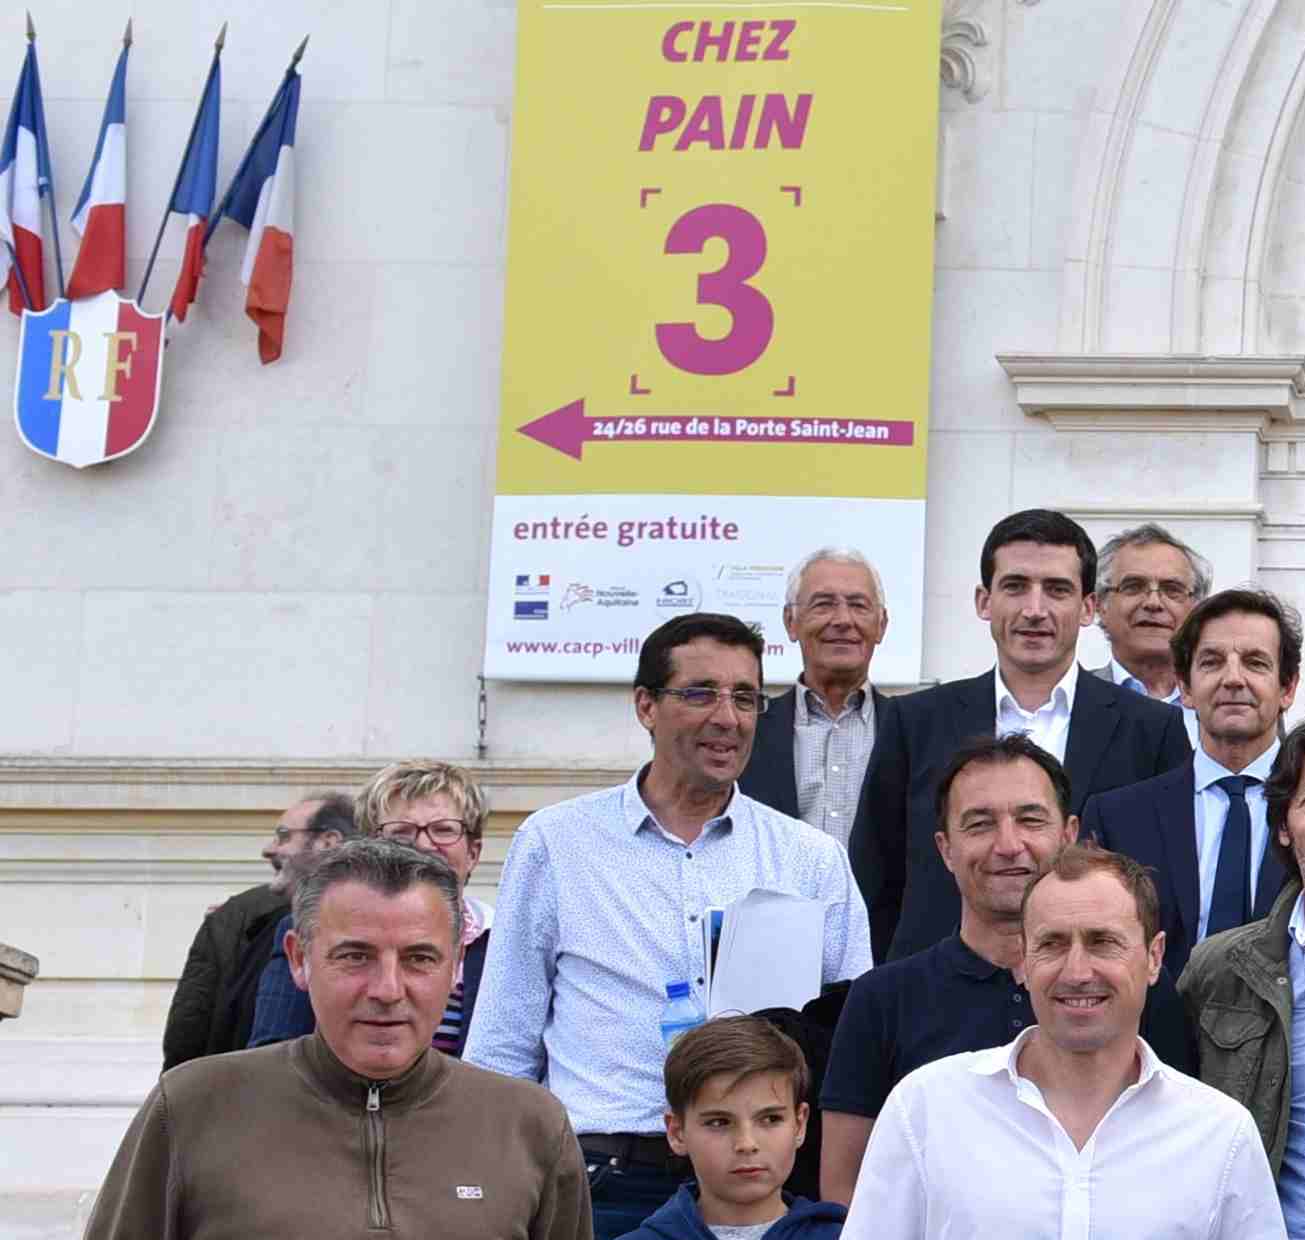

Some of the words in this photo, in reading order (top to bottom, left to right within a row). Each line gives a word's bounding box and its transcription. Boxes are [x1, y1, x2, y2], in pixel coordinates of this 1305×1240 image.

[661, 20, 797, 63] CHEZ
[638, 93, 813, 152] PAIN
[655, 203, 775, 376] 3
[592, 417, 647, 438] 24/26
[650, 420, 682, 435] rue
[686, 418, 709, 436] de
[713, 418, 731, 436] la
[735, 420, 786, 437] Porte
[790, 420, 890, 439] Saint-Jean
[513, 515, 608, 541] entrée
[617, 515, 739, 547] gratuite
